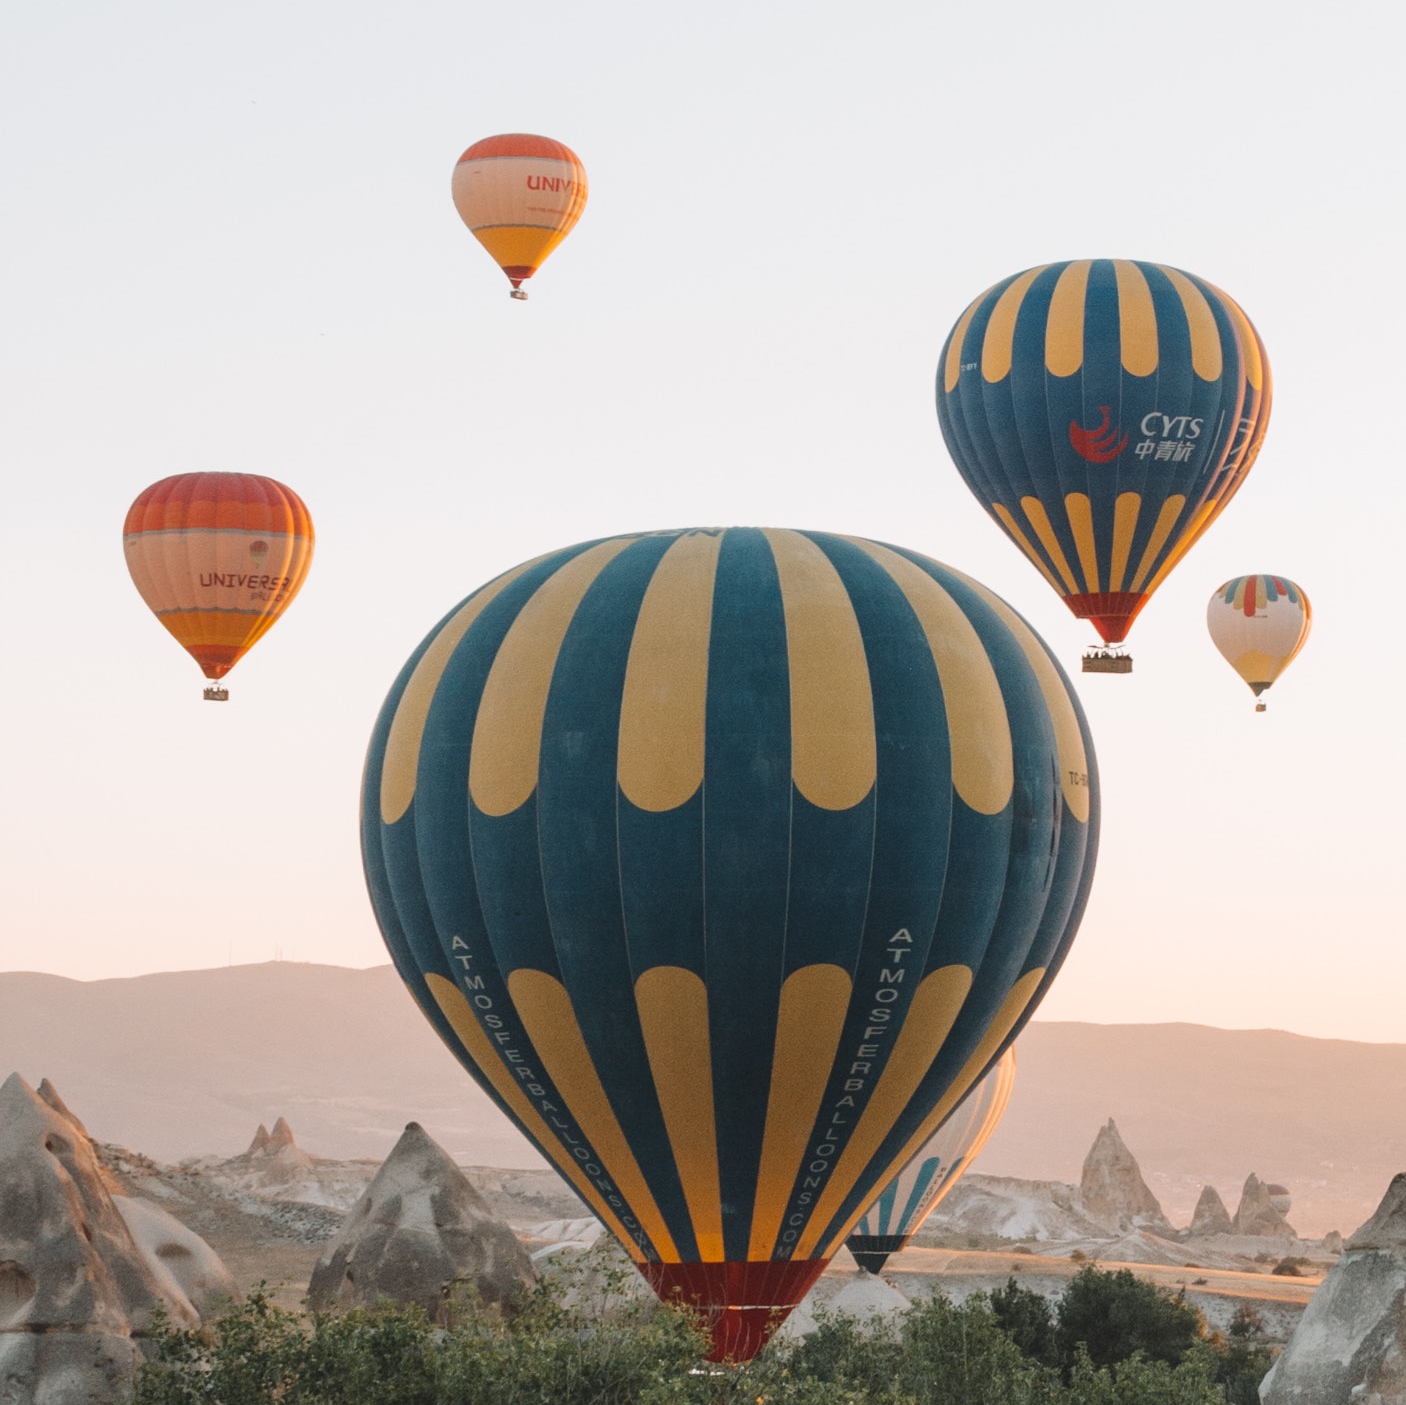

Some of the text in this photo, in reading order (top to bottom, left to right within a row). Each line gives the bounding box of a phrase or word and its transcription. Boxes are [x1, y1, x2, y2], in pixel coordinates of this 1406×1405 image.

[1140, 412, 1204, 439] CYTS
[1134, 439, 1196, 463] 中青旅
[775, 927, 913, 1259] ATMOSFERBALLOONS.COM
